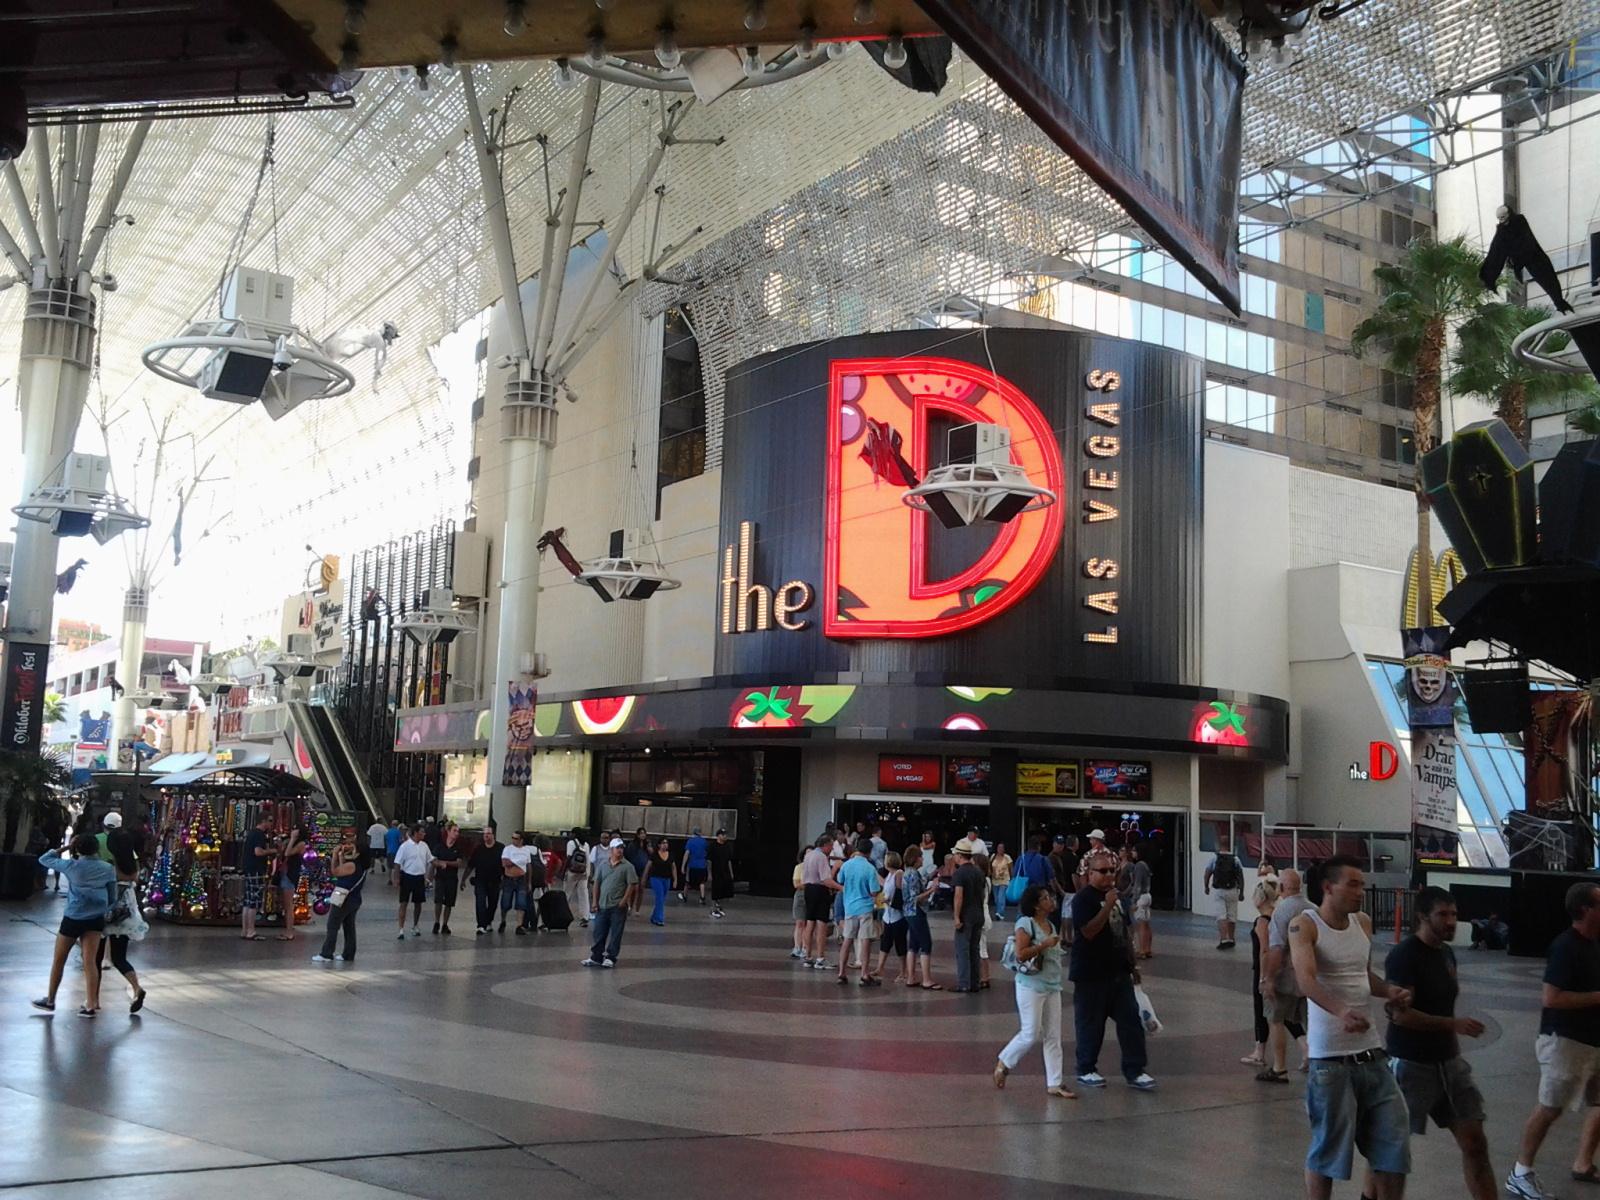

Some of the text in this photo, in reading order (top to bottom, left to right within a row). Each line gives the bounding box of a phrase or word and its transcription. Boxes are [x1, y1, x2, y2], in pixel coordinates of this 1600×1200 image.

[722, 356, 1066, 638] the D
[1084, 368, 1121, 643] LAS VEGAS
[1350, 741, 1399, 781] the D
[1422, 743, 1455, 765] Drac
[1414, 763, 1457, 792] Vamps
